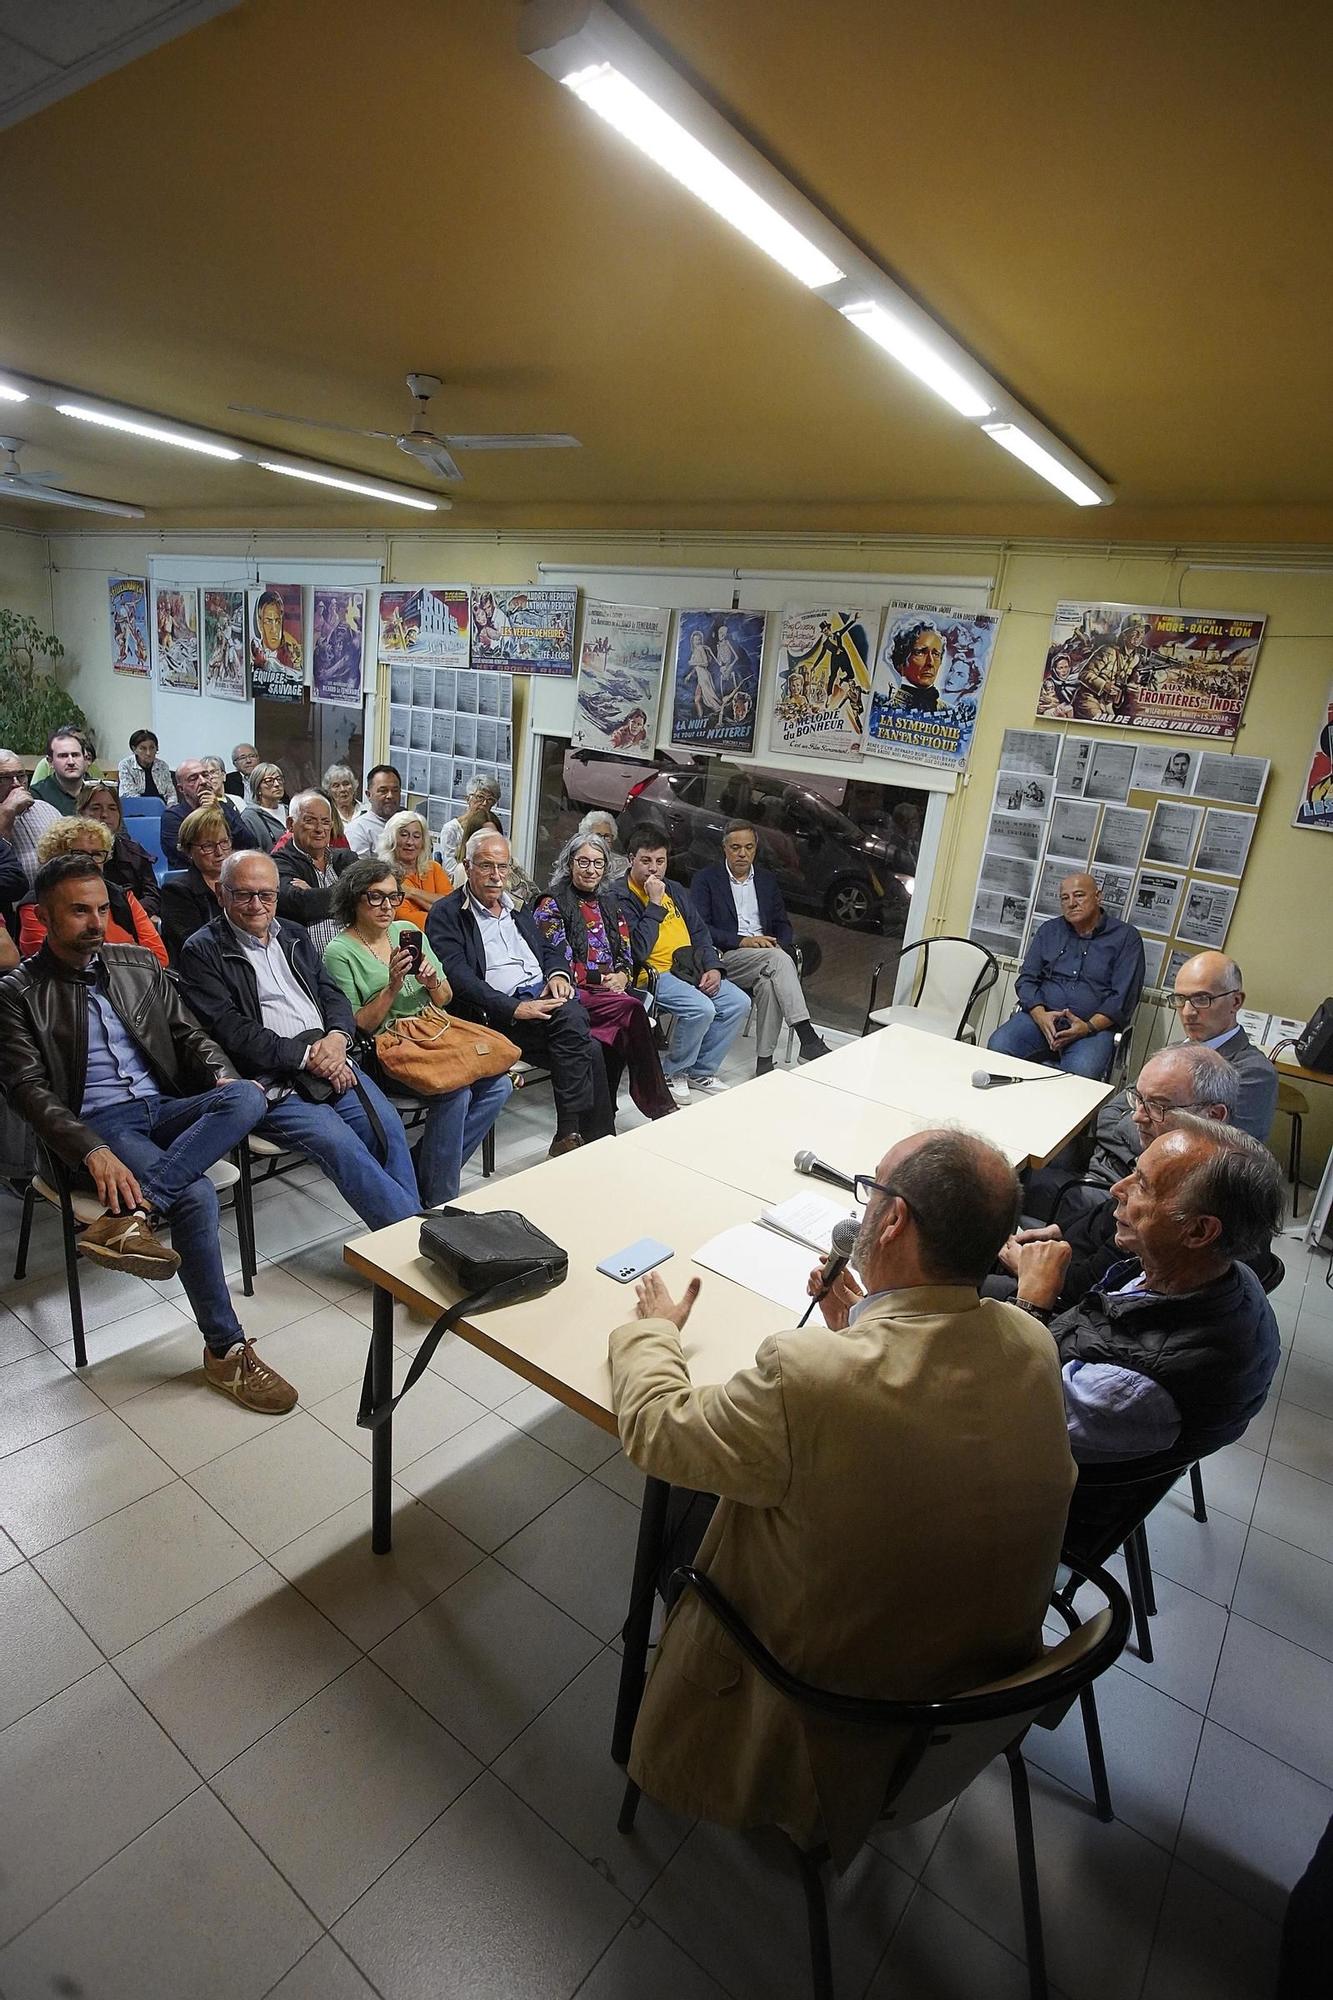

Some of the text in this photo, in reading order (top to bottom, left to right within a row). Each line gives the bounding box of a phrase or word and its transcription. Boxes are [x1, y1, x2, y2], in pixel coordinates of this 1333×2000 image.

[550, 591, 576, 601] HEPBURN
[551, 601, 575, 611] PERKINS
[502, 628, 566, 638] LES VERTES DEMEURES
[1157, 622, 1252, 638] MORE BACALL LOM
[268, 684, 303, 696] SAUVAGE
[1161, 683, 1183, 692] AUX
[1209, 694, 1243, 713] INDES
[676, 718, 709, 731] LA NUIT
[783, 721, 794, 731] La
[880, 714, 960, 740] LA SYMPHONIE
[1092, 713, 1113, 723] AAN
[1114, 714, 1130, 724] DE
[1133, 716, 1168, 729] GRENS
[1169, 720, 1188, 732] VAN
[783, 719, 844, 740] du BONHEUR
[877, 727, 958, 752] FANTASTIQUE
